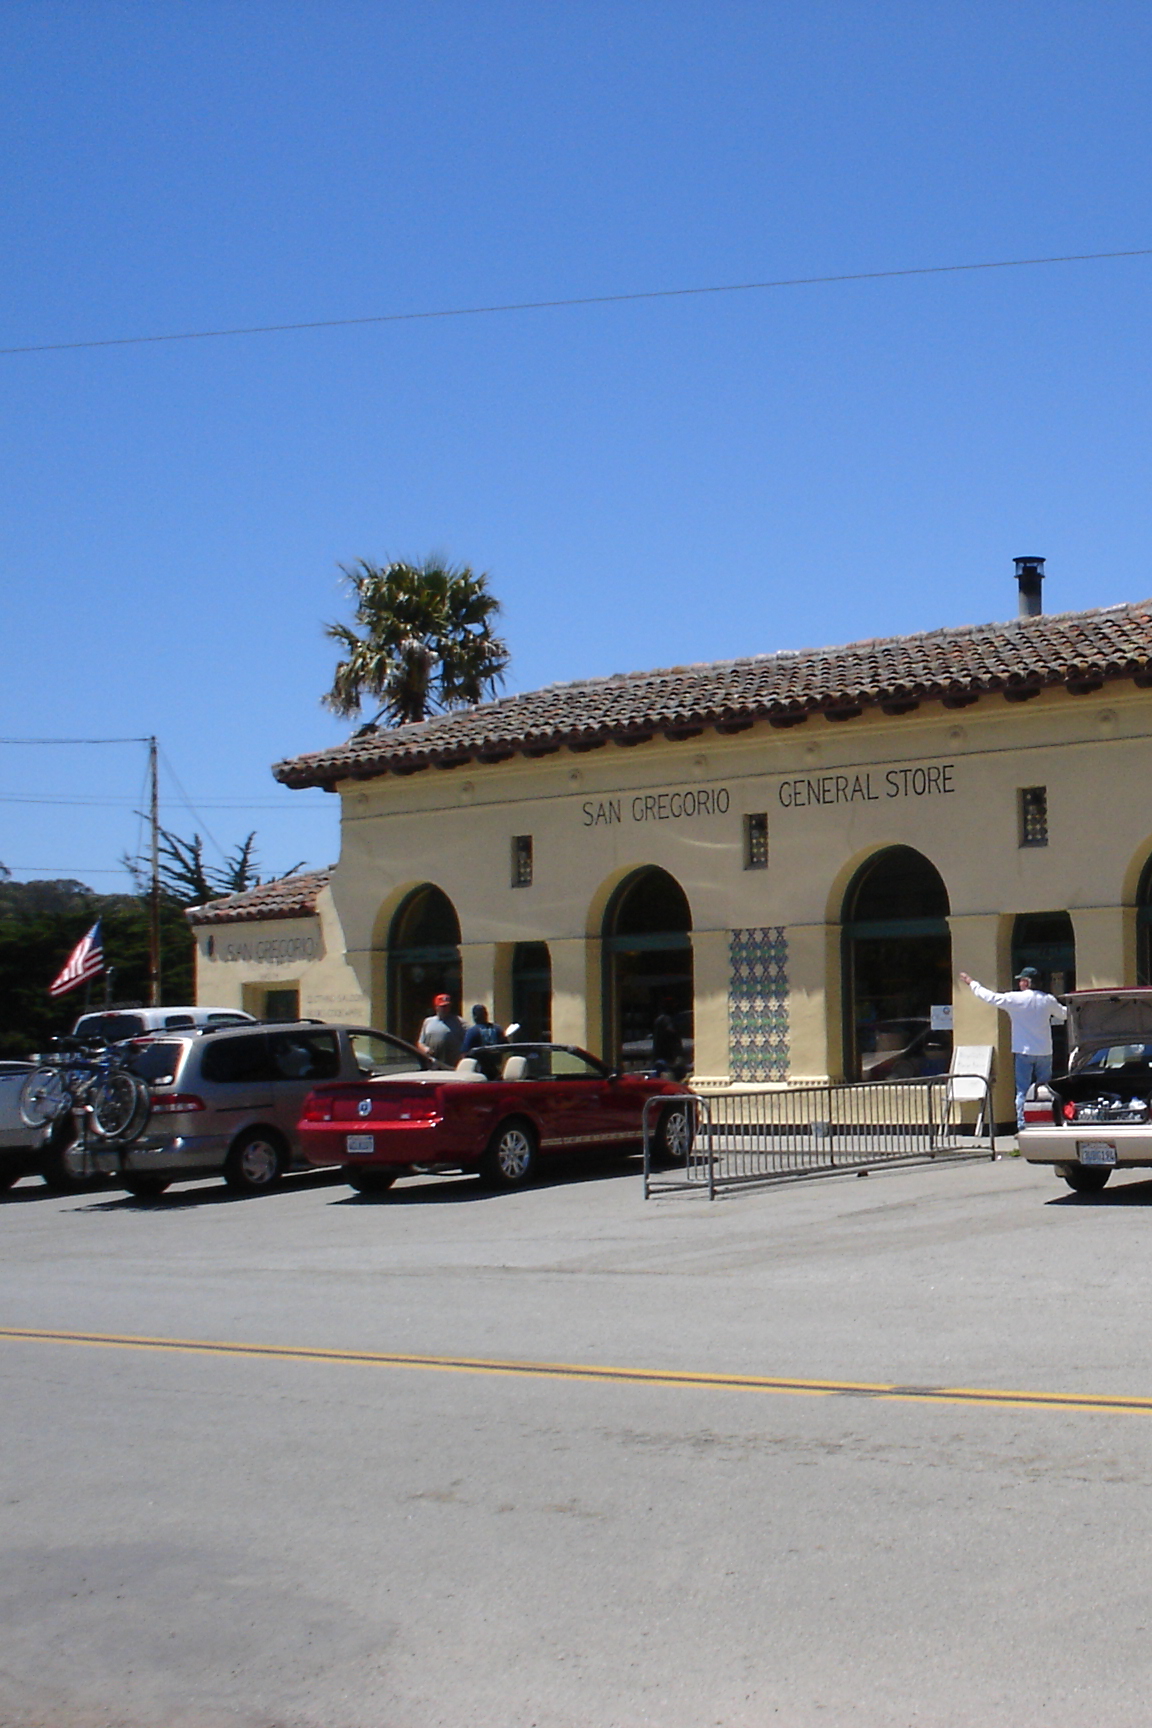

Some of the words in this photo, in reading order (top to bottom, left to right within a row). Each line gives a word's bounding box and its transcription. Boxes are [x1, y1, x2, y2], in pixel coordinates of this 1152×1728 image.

[582, 799, 621, 827] SAN
[632, 788, 730, 822] GREGORIO
[778, 773, 879, 808] GENERAL
[885, 765, 955, 799] STORE
[225, 943, 252, 961] SAN
